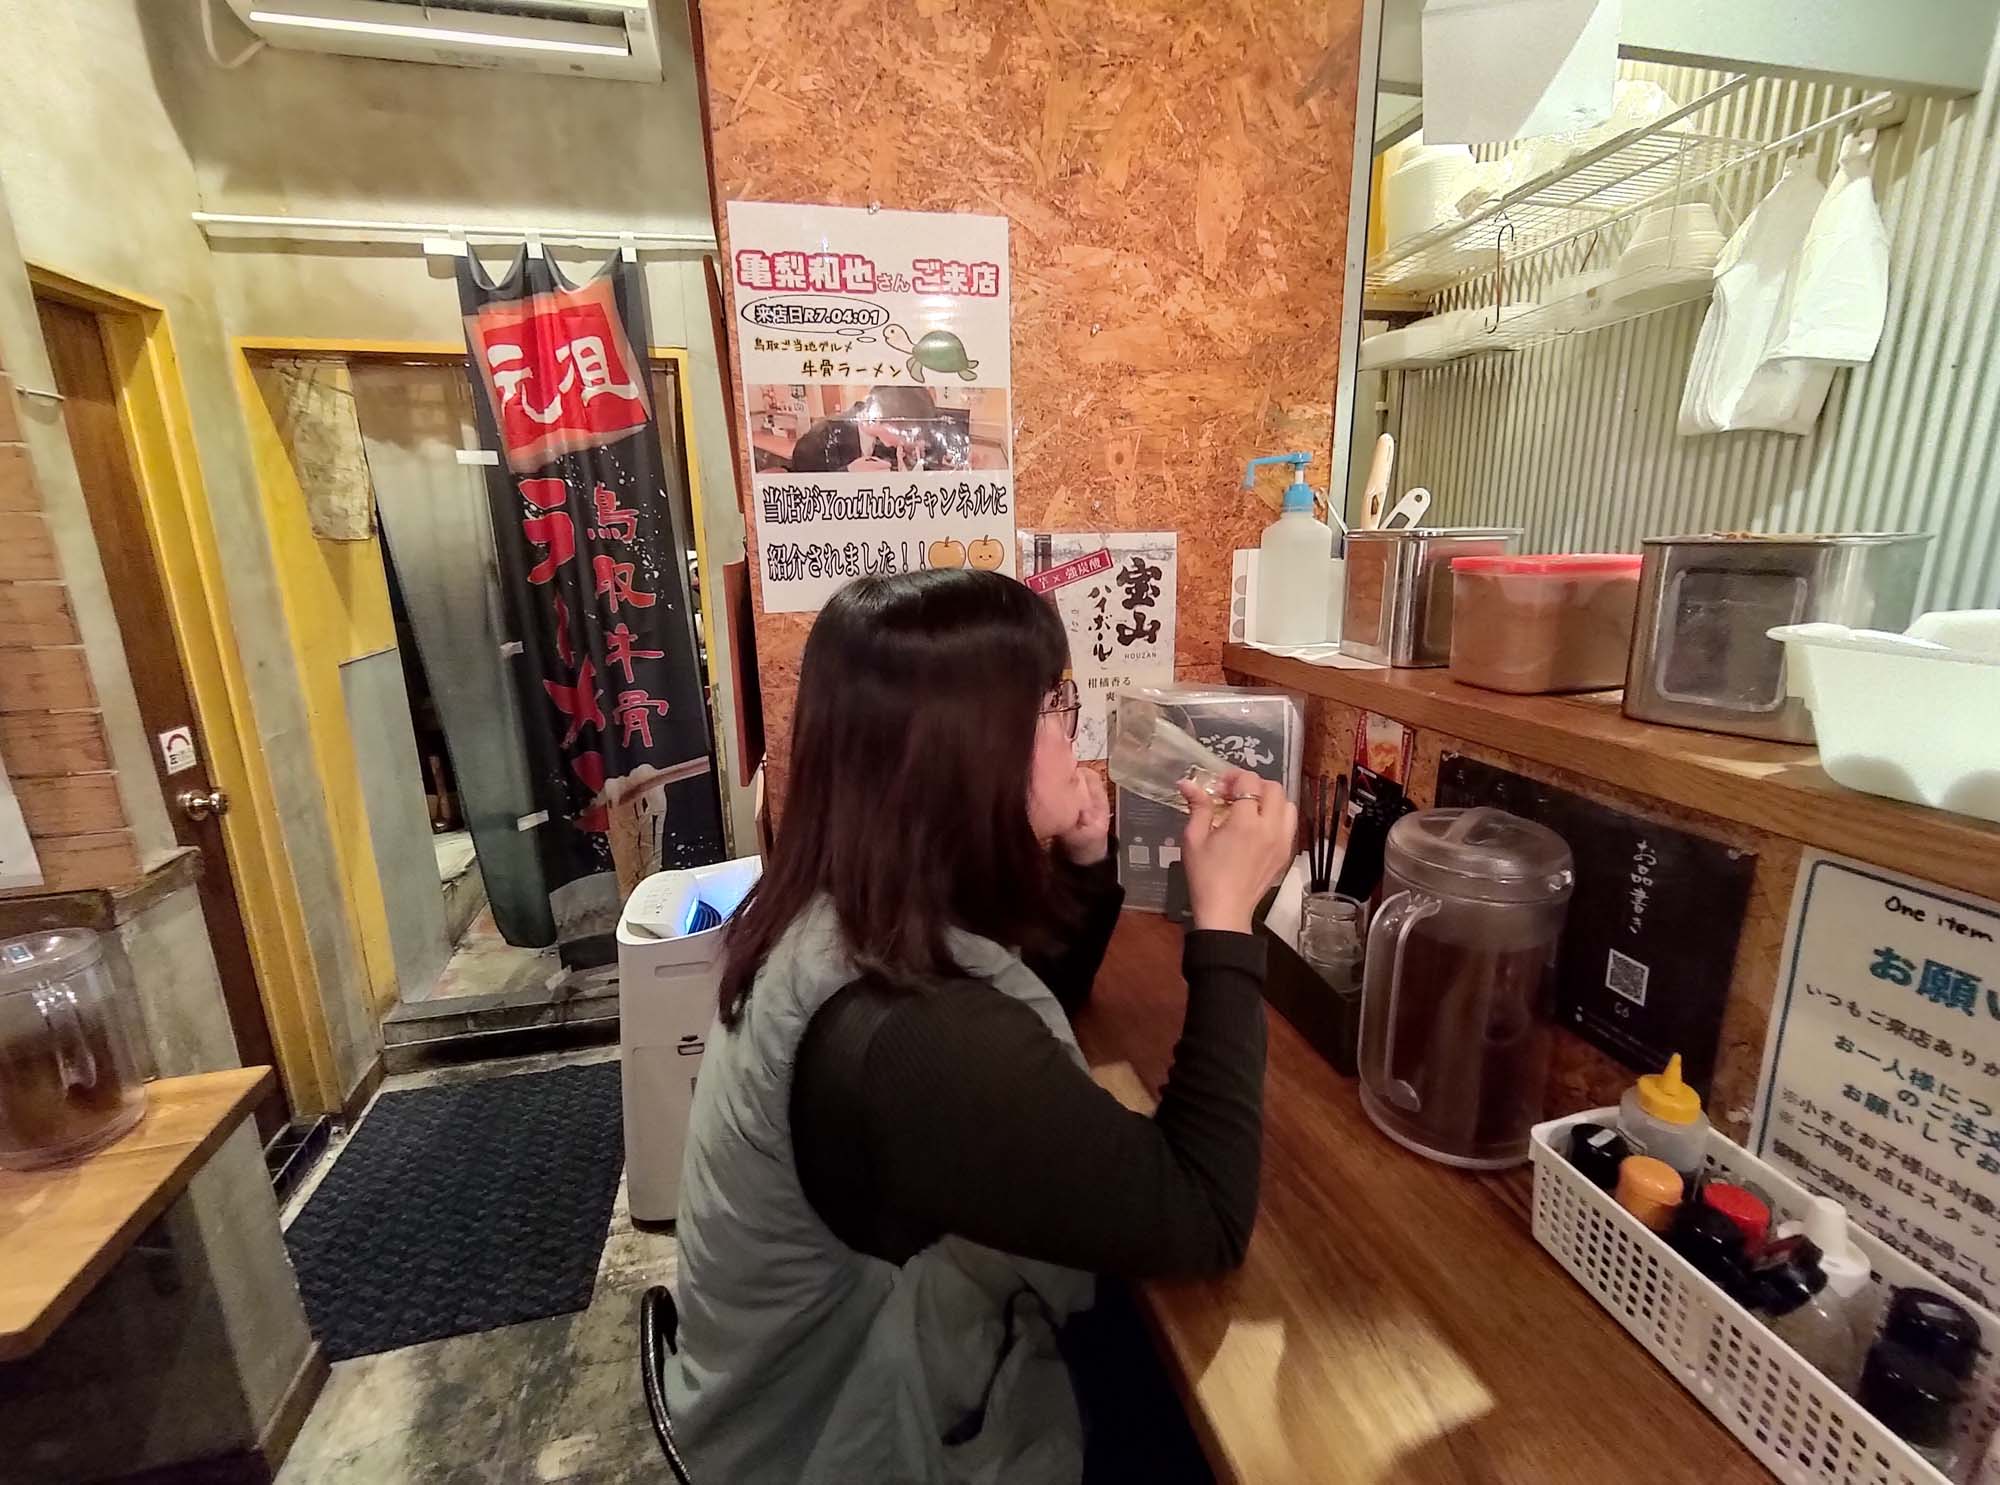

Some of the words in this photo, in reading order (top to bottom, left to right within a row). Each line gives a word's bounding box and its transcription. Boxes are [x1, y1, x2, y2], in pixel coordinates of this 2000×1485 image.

[754, 337, 853, 353] 鳥取ご当地グルメ
[801, 359, 902, 378] 牛骨ラーメン
[763, 483, 1008, 524] 当店がYouTubeチャンネルに
[586, 481, 670, 748] 鳥取牛骨
[1087, 584, 1113, 662] ハイボール
[1116, 557, 1162, 646] 宝山
[1124, 652, 1157, 660] HOUZAN
[1885, 896, 1926, 922] One
[1937, 913, 1993, 943] item
[1778, 1109, 2000, 1248] ※ご不明な点はスタッ
